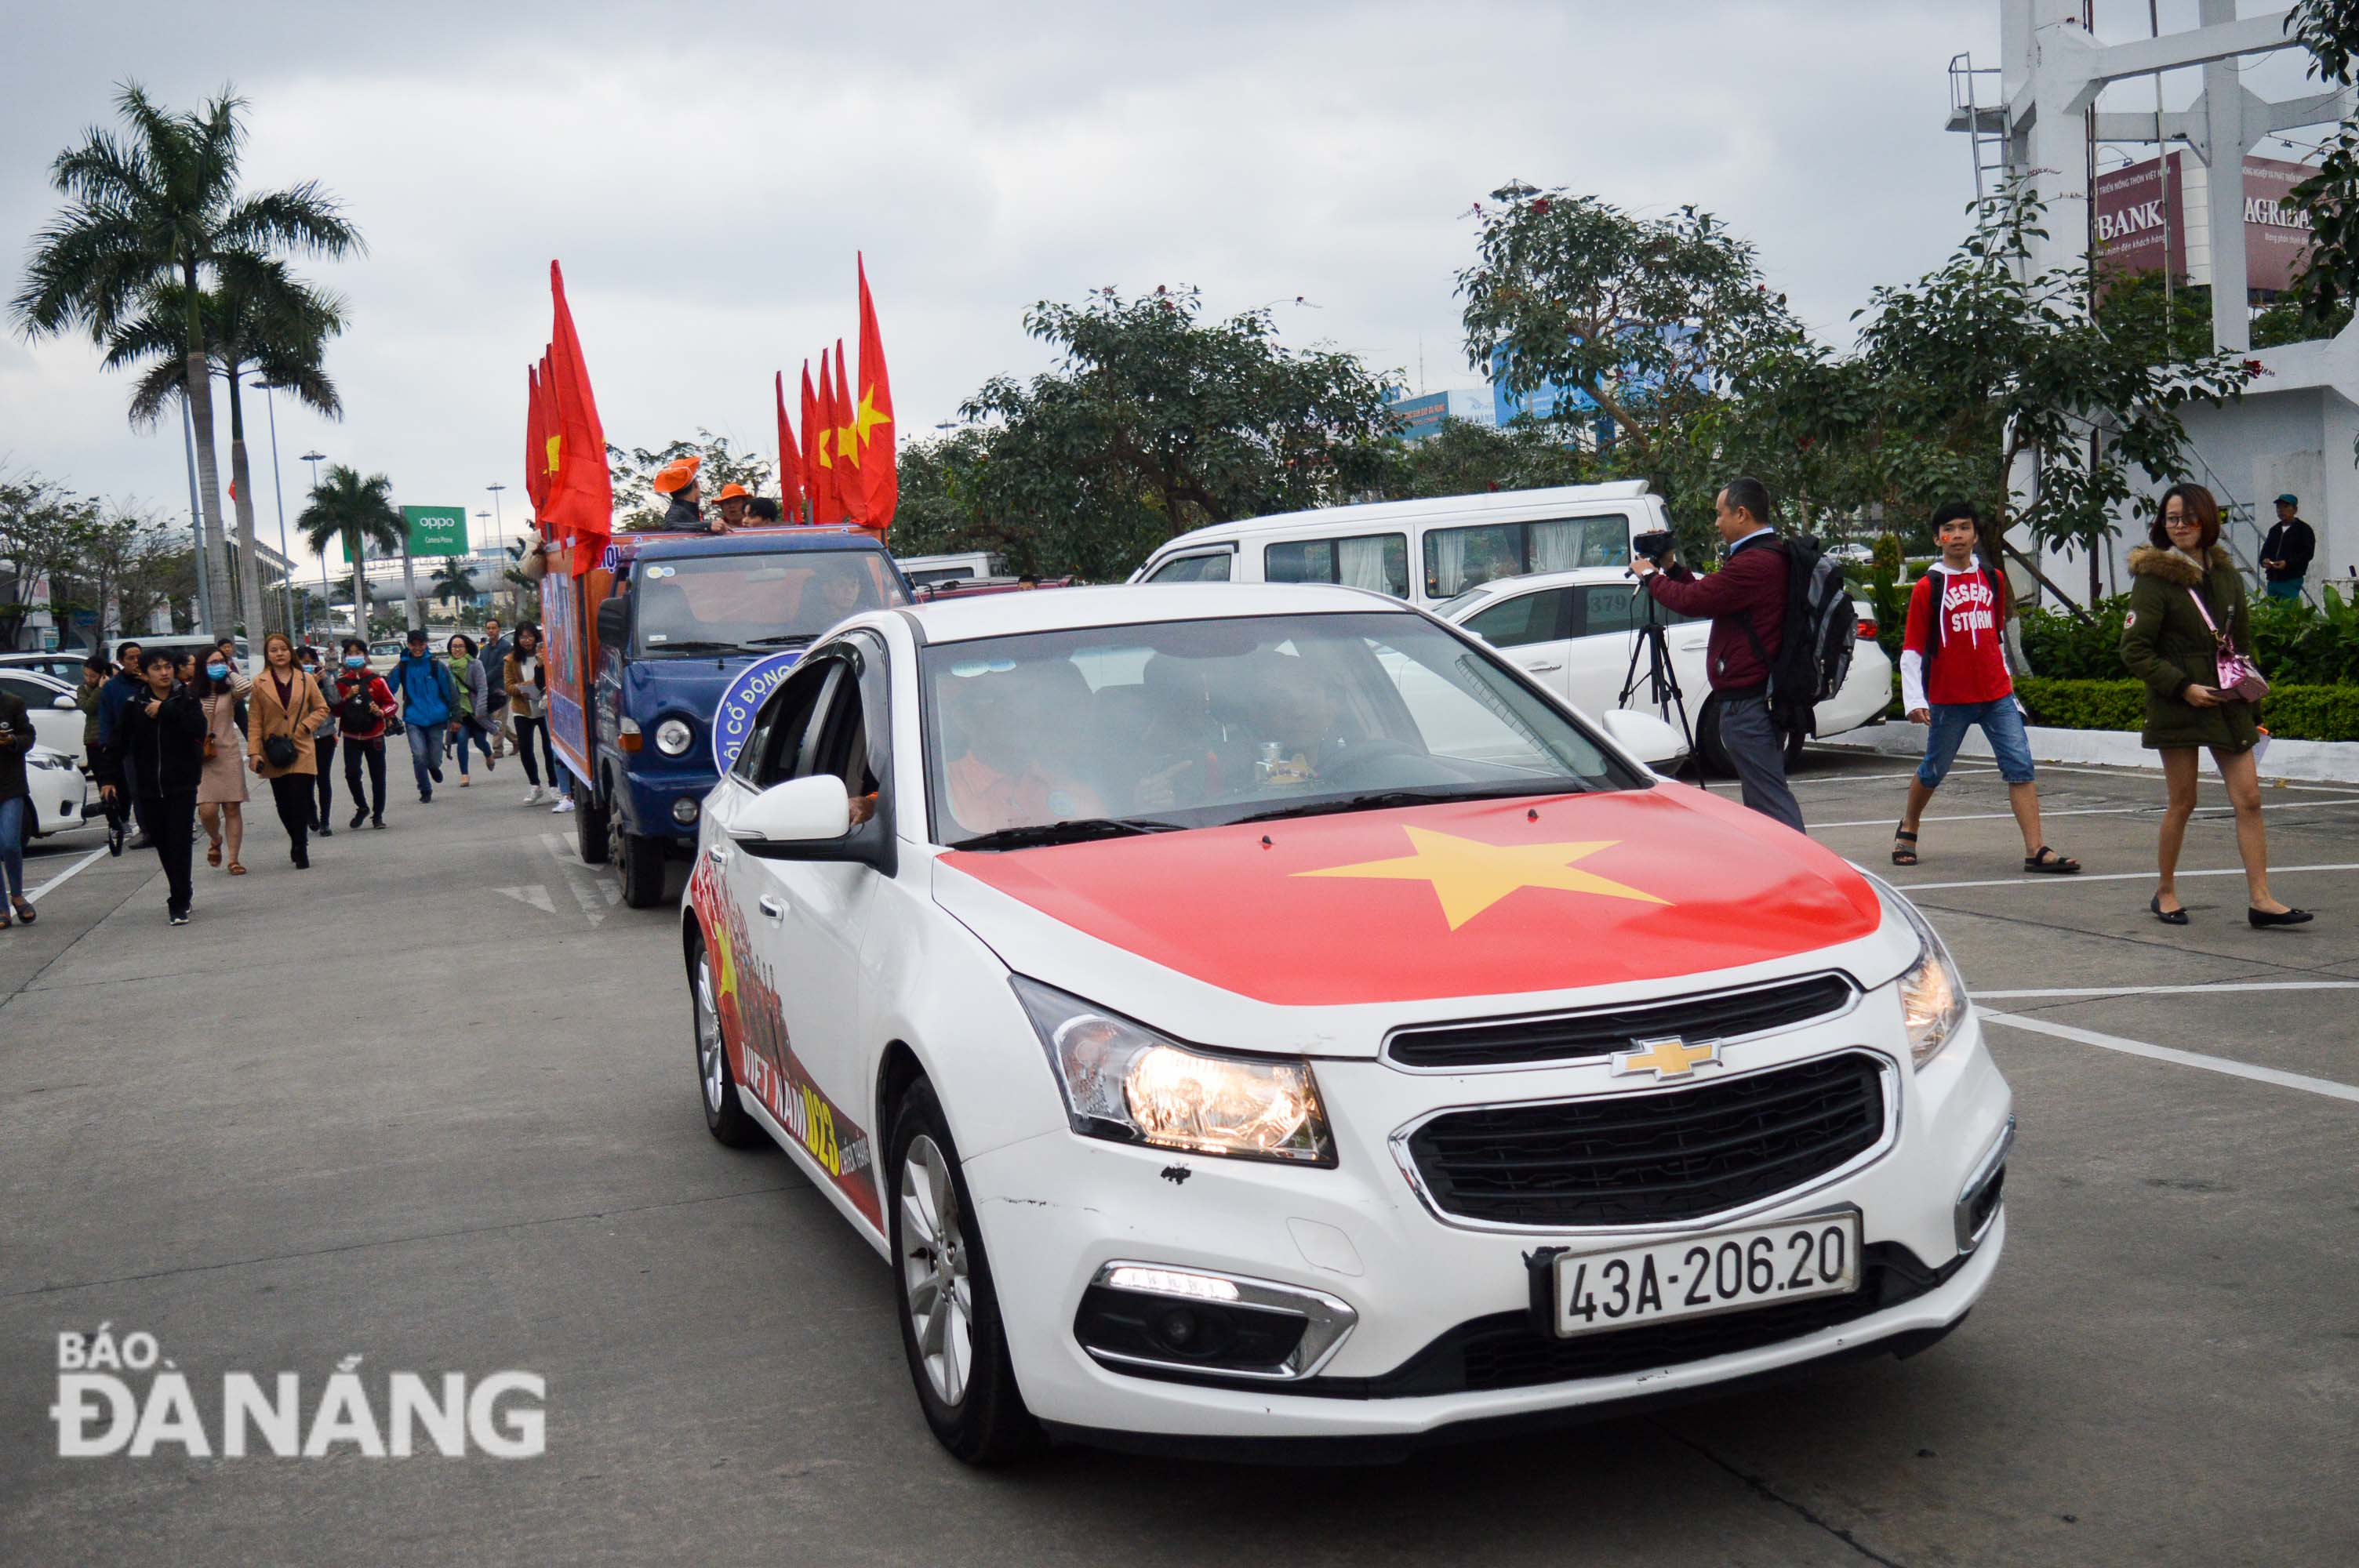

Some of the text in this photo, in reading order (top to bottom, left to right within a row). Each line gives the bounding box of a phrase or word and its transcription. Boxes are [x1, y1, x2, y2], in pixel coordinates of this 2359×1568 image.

[2098, 199, 2165, 241] BANK
[1943, 583, 1993, 611] DESERT
[1952, 610, 1993, 632] STORM
[726, 702, 746, 735] CỔ
[1569, 1225, 1845, 1323] 43A-206.20
